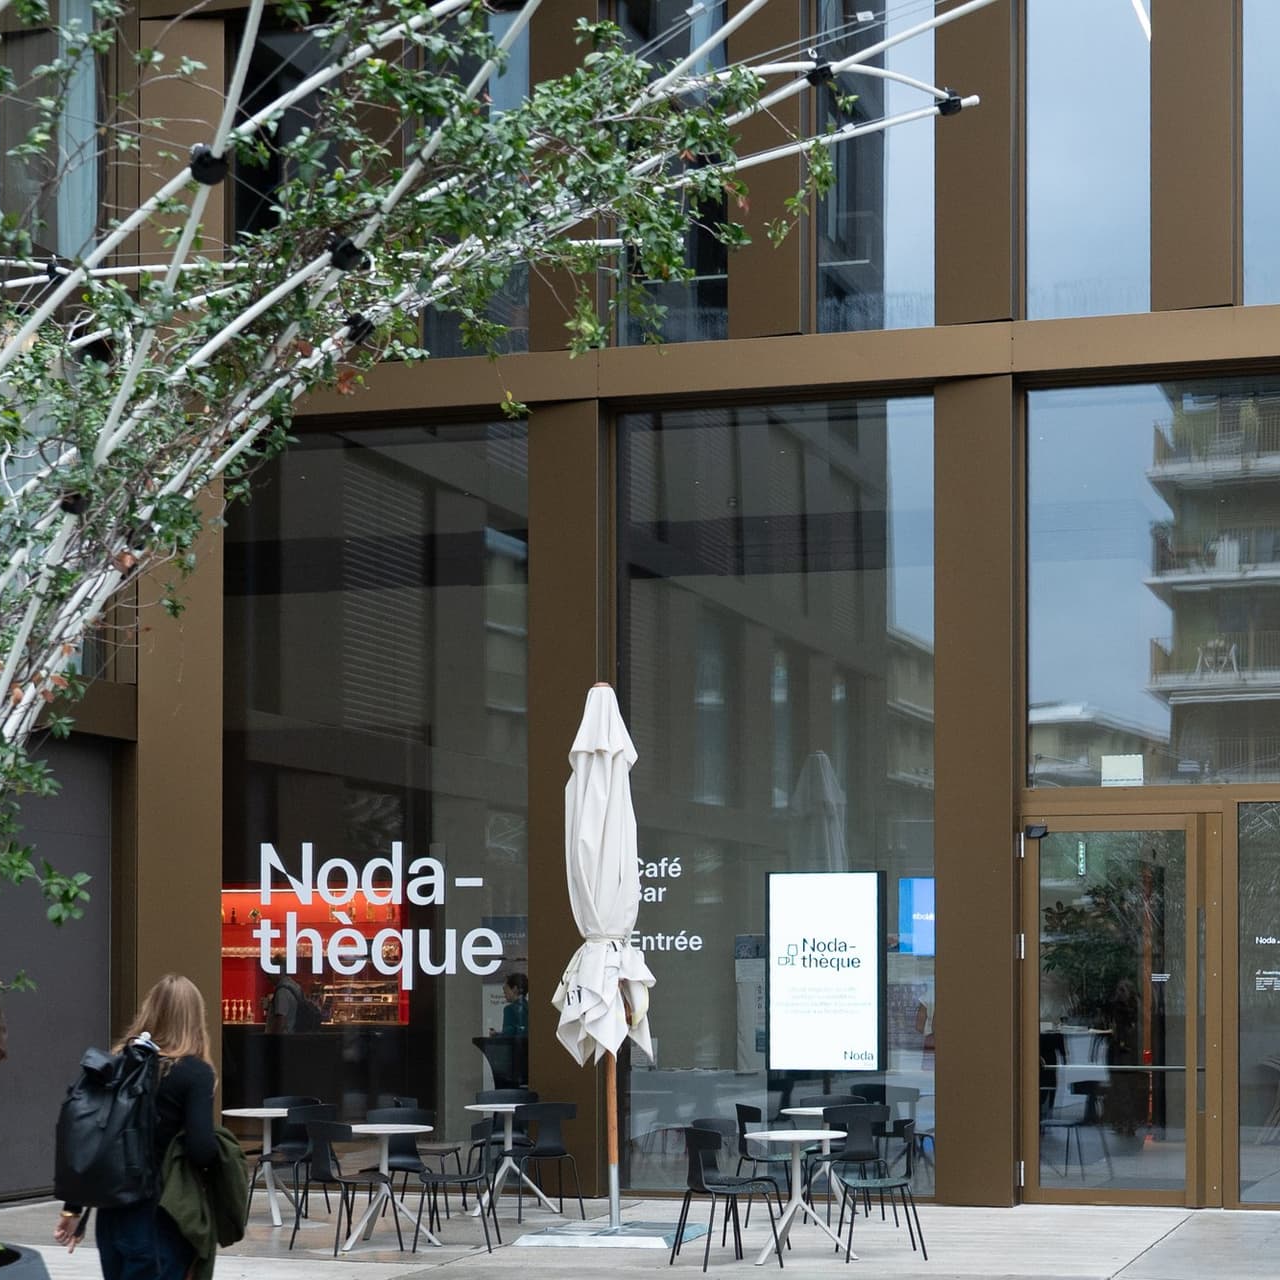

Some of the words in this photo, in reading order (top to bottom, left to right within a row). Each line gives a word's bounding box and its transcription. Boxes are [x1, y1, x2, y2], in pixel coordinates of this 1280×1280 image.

[259, 841, 484, 905] Noda-
[629, 930, 703, 951] Entrée
[802, 937, 857, 953] Noda-
[1255, 936, 1276, 945] Noda
[252, 911, 504, 991] thèque
[801, 953, 861, 971] thèque
[843, 1050, 874, 1061] Noda
